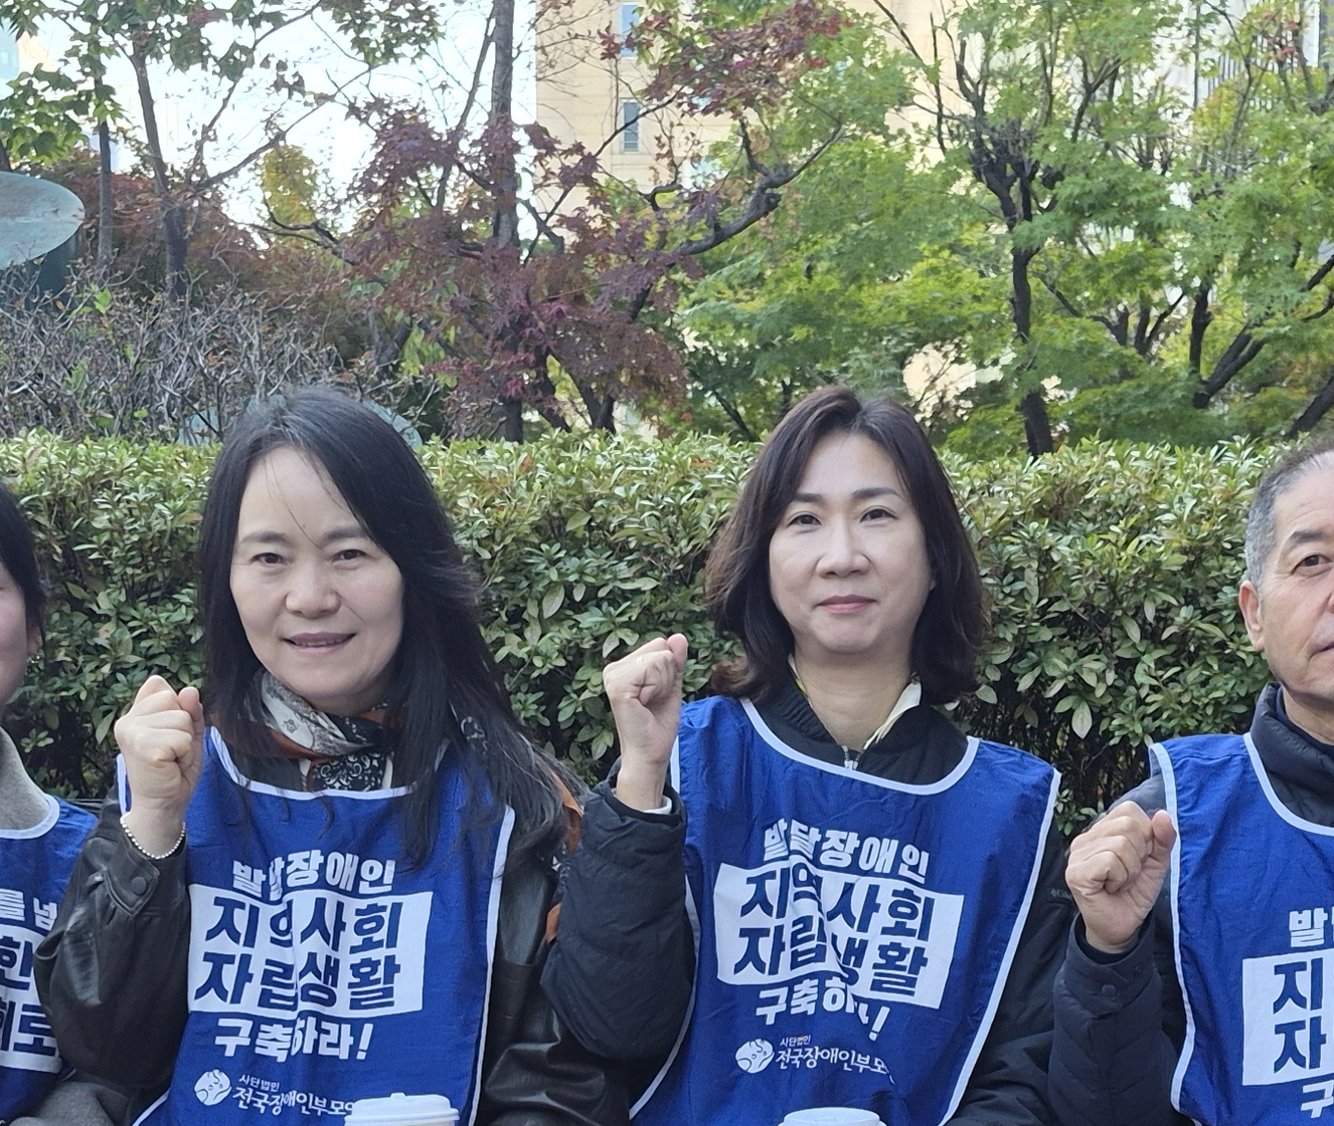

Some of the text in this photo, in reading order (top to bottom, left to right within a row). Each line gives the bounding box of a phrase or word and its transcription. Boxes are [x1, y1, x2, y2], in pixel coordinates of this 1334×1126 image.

[763, 818, 929, 884] 발달장애인
[194, 951, 401, 1011] 자립생활
[734, 914, 928, 997] 자립생활
[756, 974, 890, 1041] 구축하!
[214, 1017, 374, 1062] 구축하라!
[775, 1046, 891, 1078] 전국장애인부모
[238, 1073, 281, 1091] 사단법인
